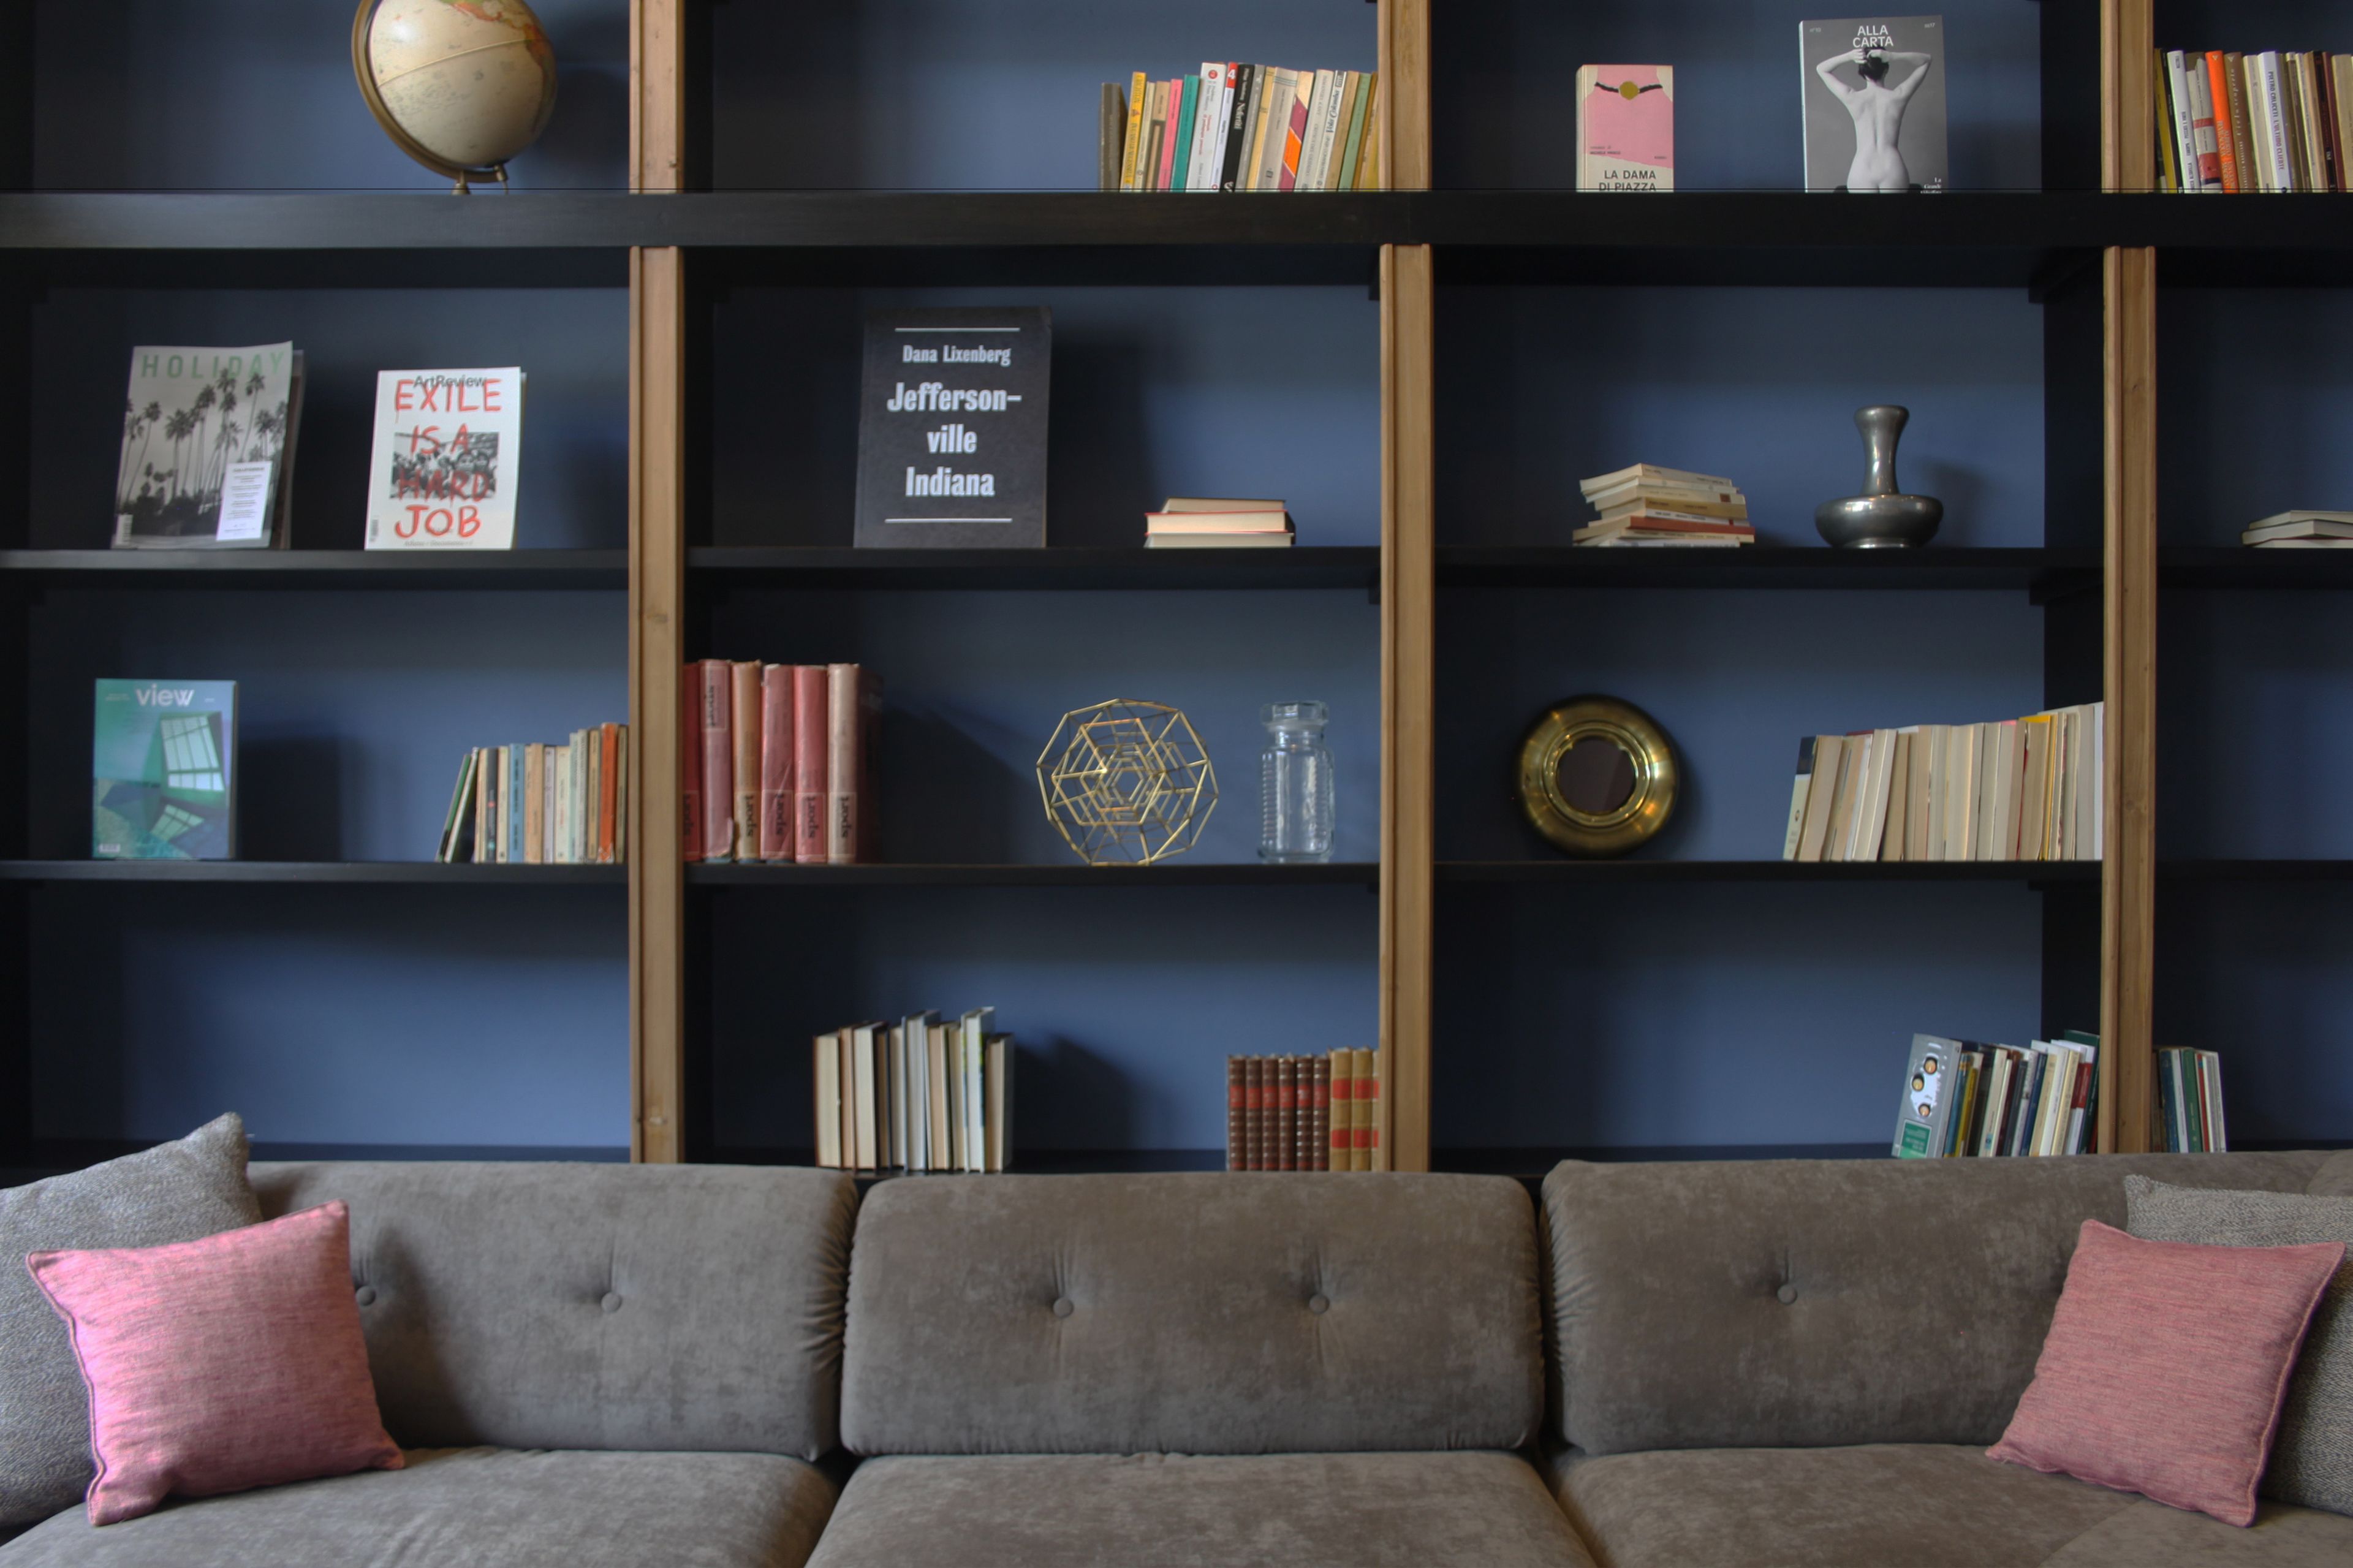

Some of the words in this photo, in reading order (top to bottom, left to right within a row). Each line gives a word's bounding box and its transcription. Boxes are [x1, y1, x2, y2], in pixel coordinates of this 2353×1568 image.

[1853, 36, 1893, 48] CARTA
[1857, 25, 1889, 36] ALLA
[2267, 70, 2276, 91] PIETRO
[1232, 101, 1246, 130] Nefertiti
[1599, 182, 1610, 191] DI
[1615, 182, 1656, 191] PIAZZA
[1604, 170, 1618, 179] LA
[1623, 170, 1656, 179] DAMA
[141, 351, 285, 379] HOLIDAY
[903, 344, 938, 363] Dana
[942, 344, 1012, 366] Lixenberg
[413, 374, 488, 388] ArtReview
[395, 379, 502, 413] EXILE
[887, 382, 1022, 412] Jefferson-
[410, 425, 441, 455] IS
[450, 422, 469, 455] A
[926, 424, 977, 453] ville
[397, 468, 490, 504] HARD
[906, 466, 995, 497] Indiana
[394, 504, 482, 539] JOB
[135, 683, 195, 708] view
[806, 797, 819, 839] sport
[839, 796, 852, 838] sport
